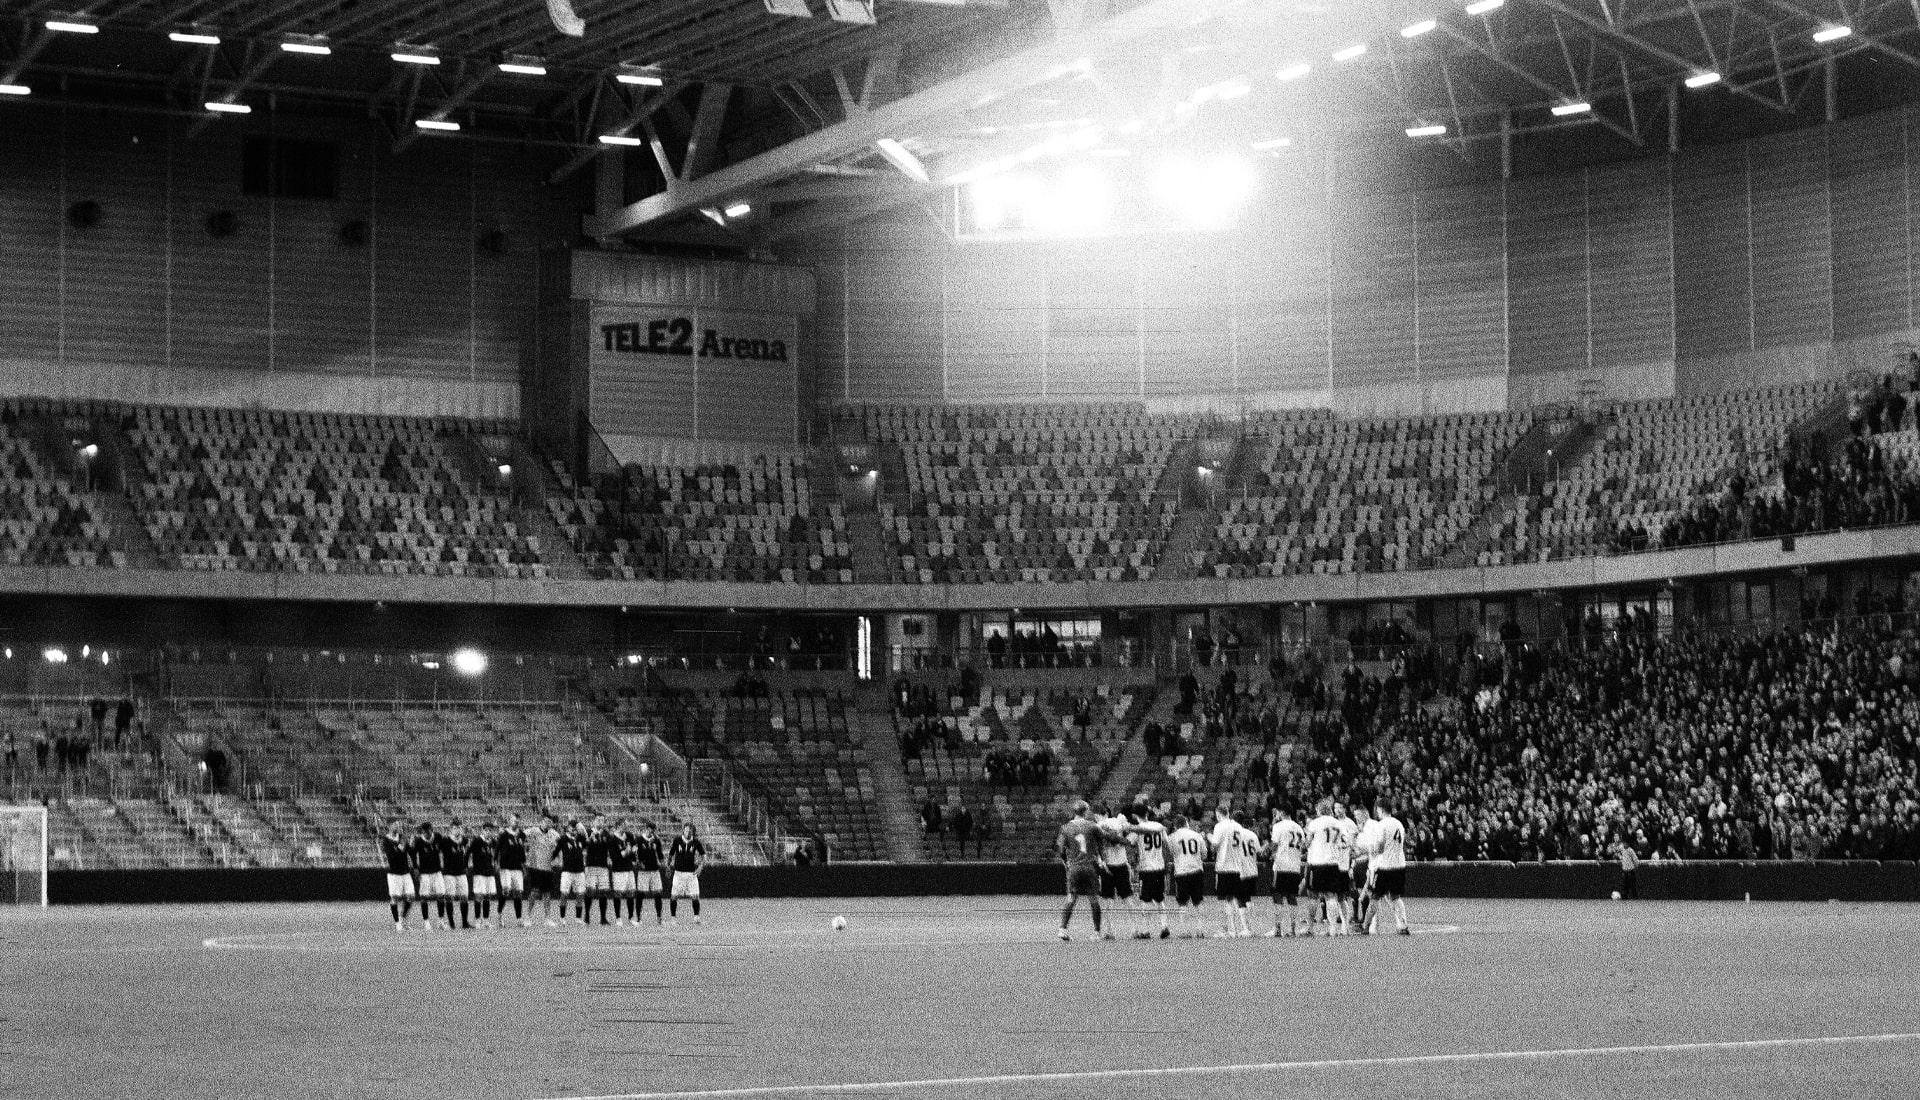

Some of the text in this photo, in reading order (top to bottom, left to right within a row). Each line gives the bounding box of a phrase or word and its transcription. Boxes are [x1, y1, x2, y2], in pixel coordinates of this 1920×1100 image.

[601, 318, 787, 362] TELE2 Arena
[1075, 833, 1087, 853] 1
[1144, 833, 1162, 851] 90
[1324, 827, 1341, 844] 17
[1392, 829, 1403, 844] 4
[1179, 838, 1198, 855] 10
